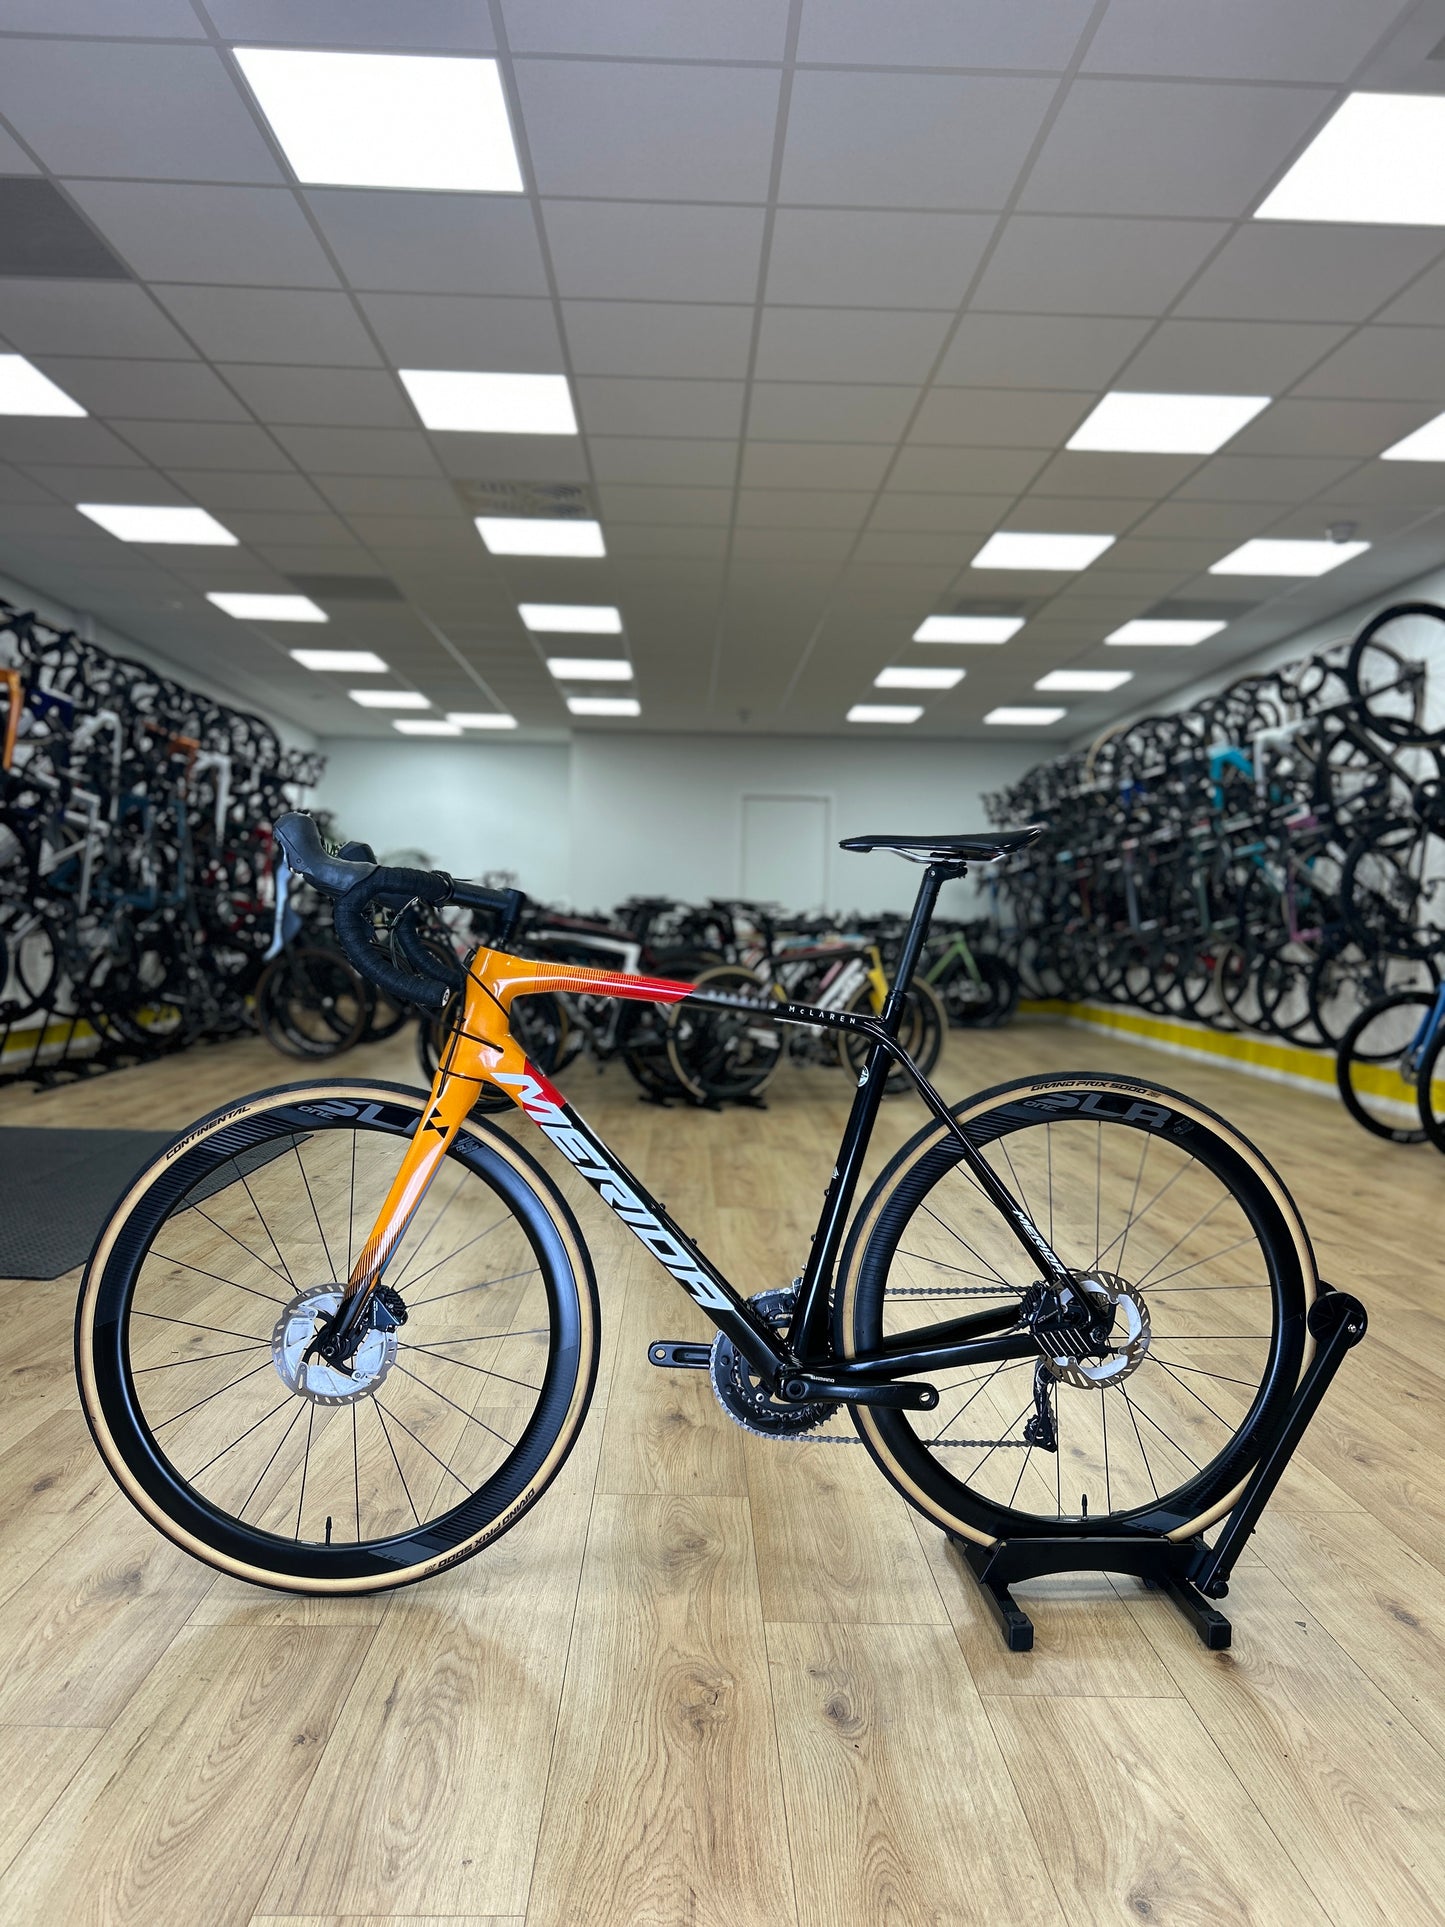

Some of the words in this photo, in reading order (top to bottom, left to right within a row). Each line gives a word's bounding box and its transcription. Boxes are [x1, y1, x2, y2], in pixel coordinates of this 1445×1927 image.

[1030, 1081, 1075, 1092] GRAND
[1076, 1080, 1109, 1088] PRIX
[1109, 1082, 1148, 1095] 5000
[166, 1106, 251, 1160] CONTINENTAL
[490, 1072, 735, 1311] MERIDA
[1012, 1209, 1068, 1275] MERIDA
[502, 1488, 535, 1525] GRAND
[474, 1522, 502, 1547] PRIX
